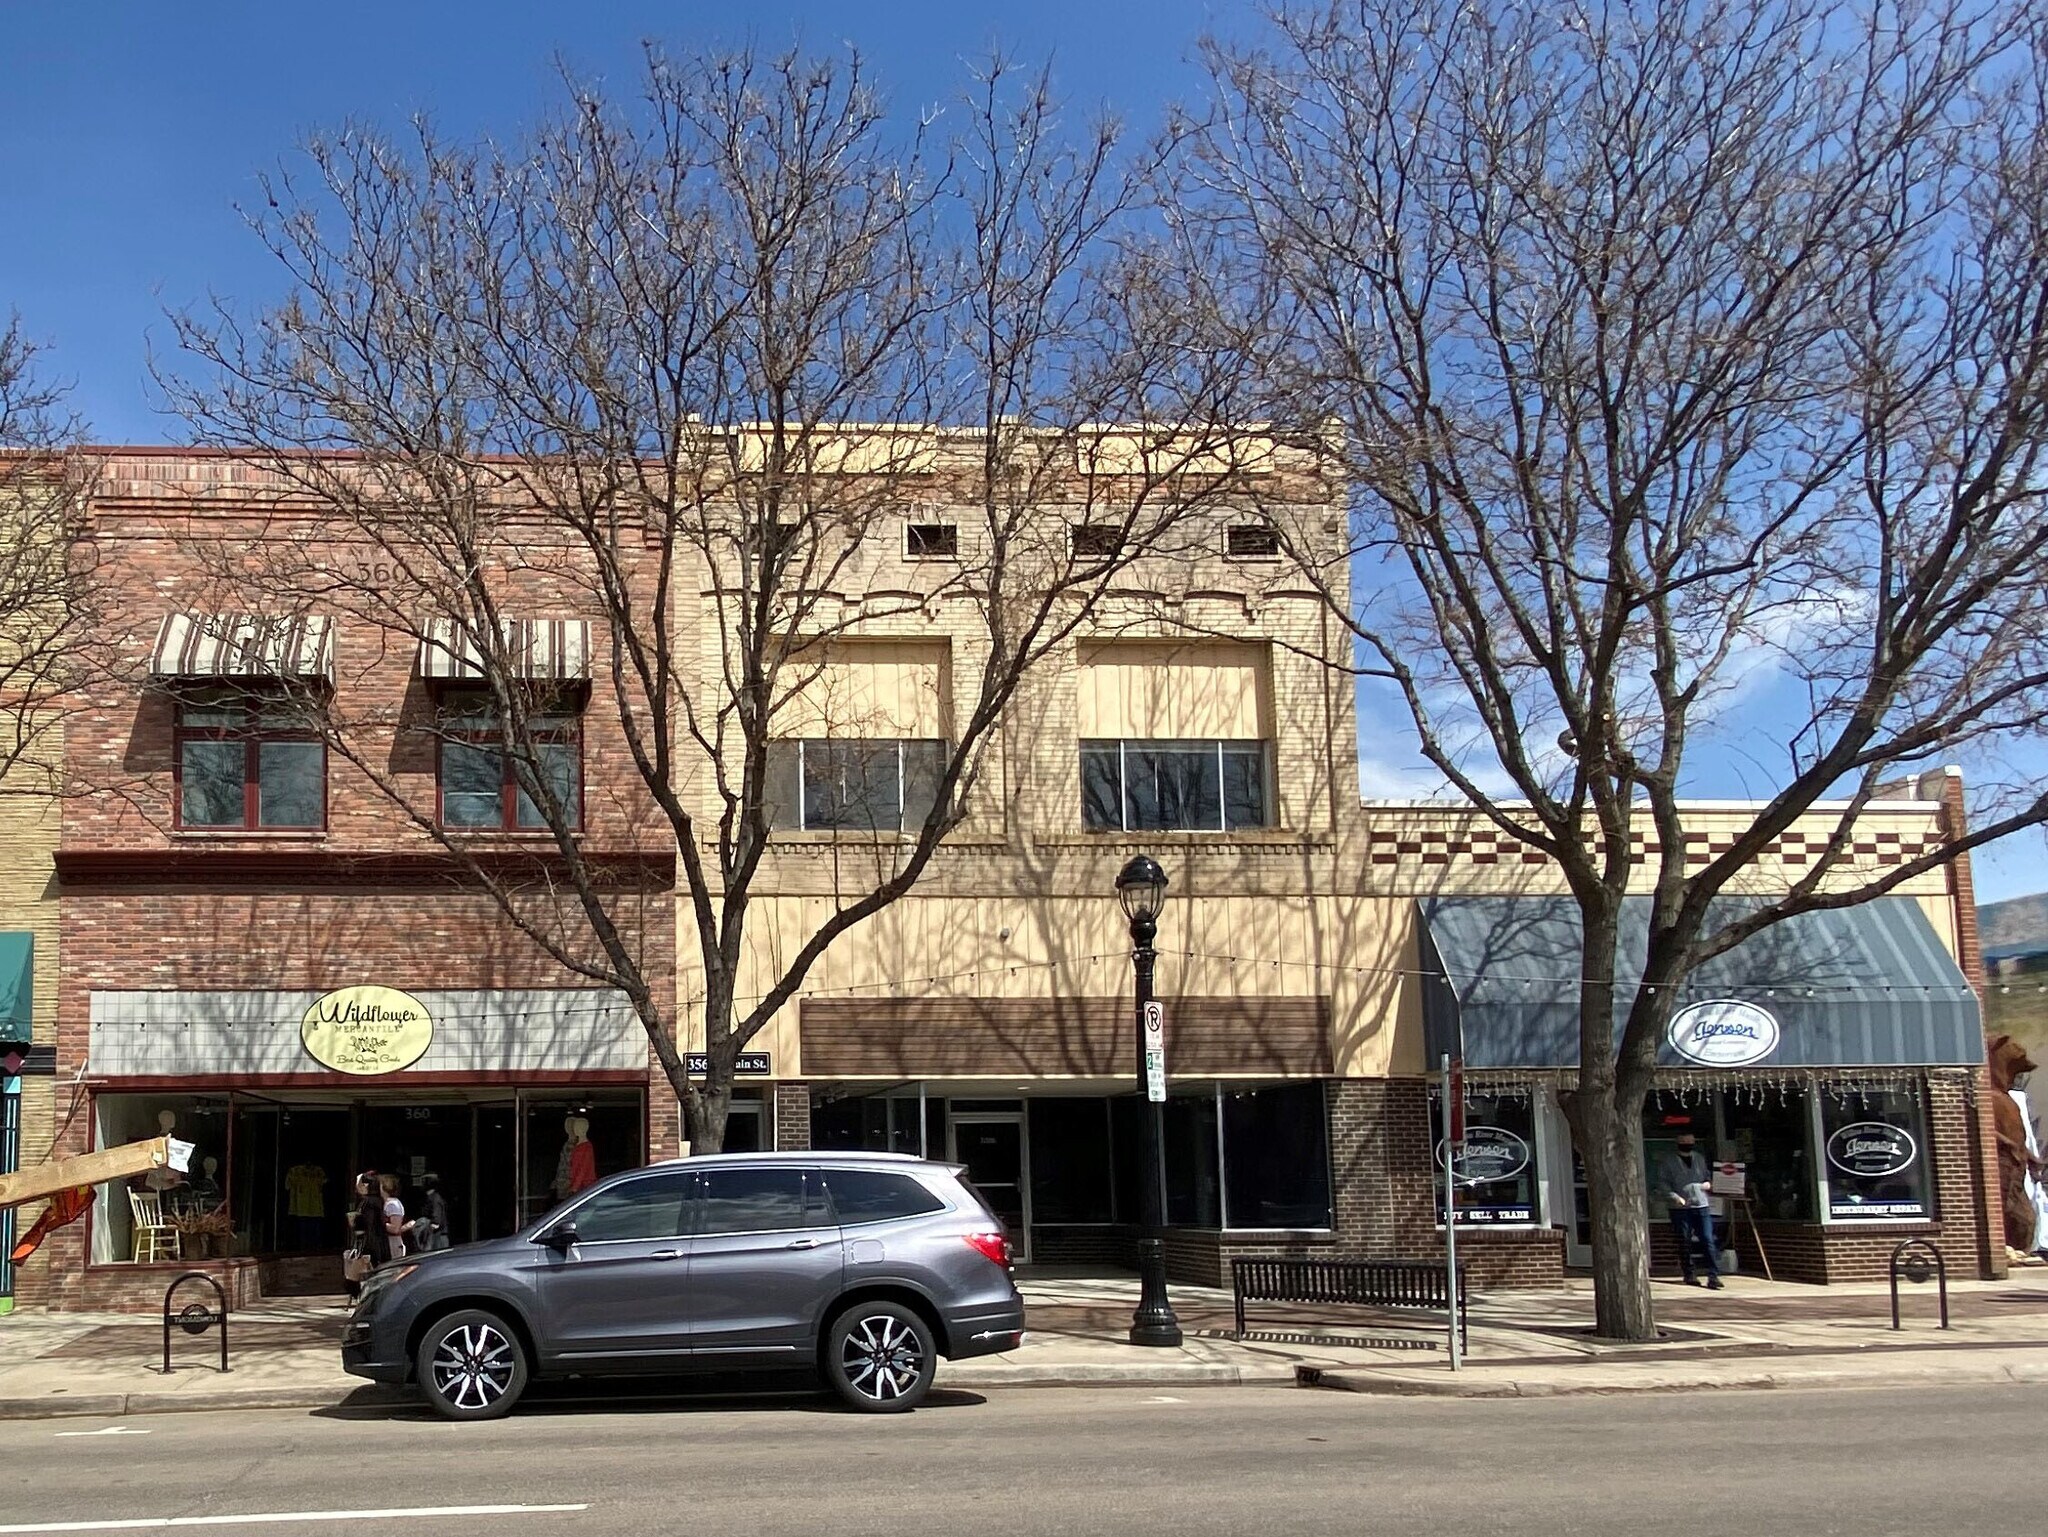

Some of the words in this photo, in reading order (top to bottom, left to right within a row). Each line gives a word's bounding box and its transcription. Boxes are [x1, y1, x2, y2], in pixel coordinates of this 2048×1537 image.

[357, 562, 407, 583] 360
[320, 1000, 418, 1024] Wildflower
[1692, 1020, 1760, 1042] Jensen
[688, 1059, 708, 1070] 356
[752, 1059, 767, 1069] St.
[405, 1108, 430, 1119] 360
[1469, 1211, 1493, 1220] SELL
[1498, 1211, 1530, 1220] TRADE
